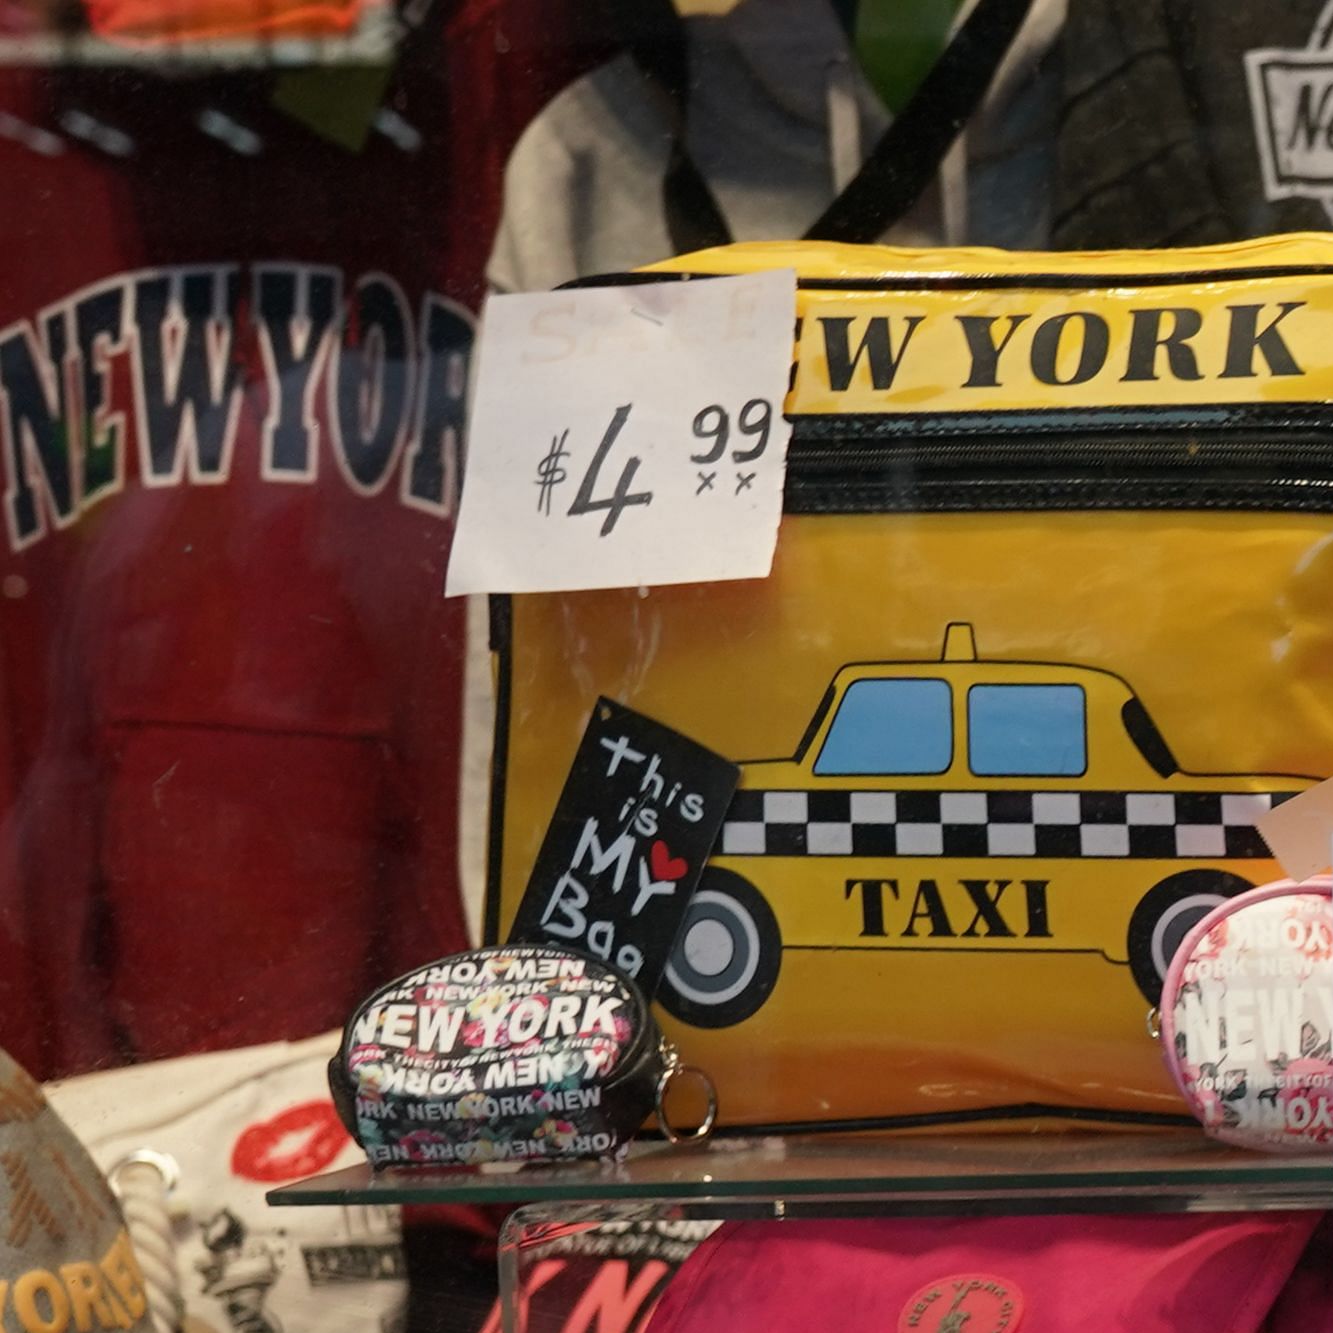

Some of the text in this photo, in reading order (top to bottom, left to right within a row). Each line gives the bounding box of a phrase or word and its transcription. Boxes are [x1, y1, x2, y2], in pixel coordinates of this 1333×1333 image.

[955, 300, 1308, 388] YORK
[619, 797, 660, 837] is
[540, 873, 646, 982] Bag
[844, 878, 1054, 939] TAXI
[353, 994, 624, 1054] NEW YORK
[406, 1101, 460, 1122] NEW
[546, 1086, 602, 1112] NEW
